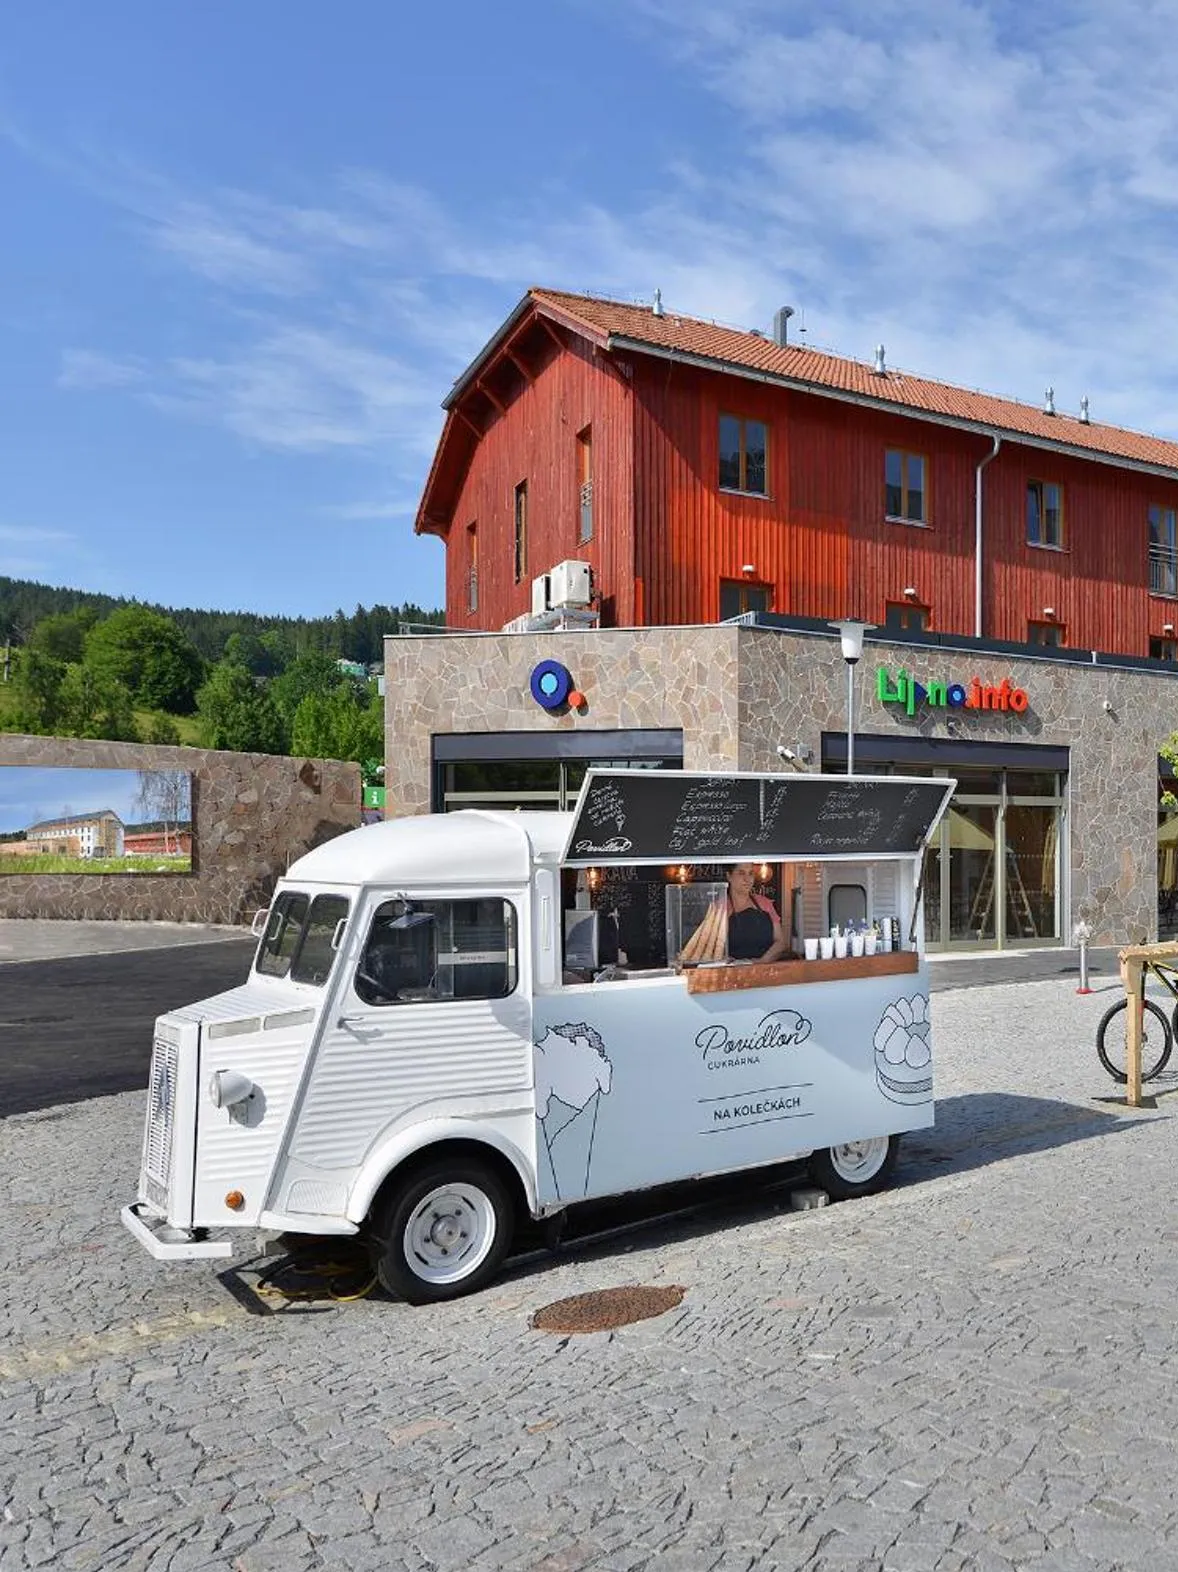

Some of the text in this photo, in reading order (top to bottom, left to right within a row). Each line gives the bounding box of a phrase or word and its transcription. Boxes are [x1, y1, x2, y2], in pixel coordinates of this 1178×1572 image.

[695, 1009, 813, 1060] Povidlon
[713, 1096, 801, 1122] NA KOLEČKÁCH
